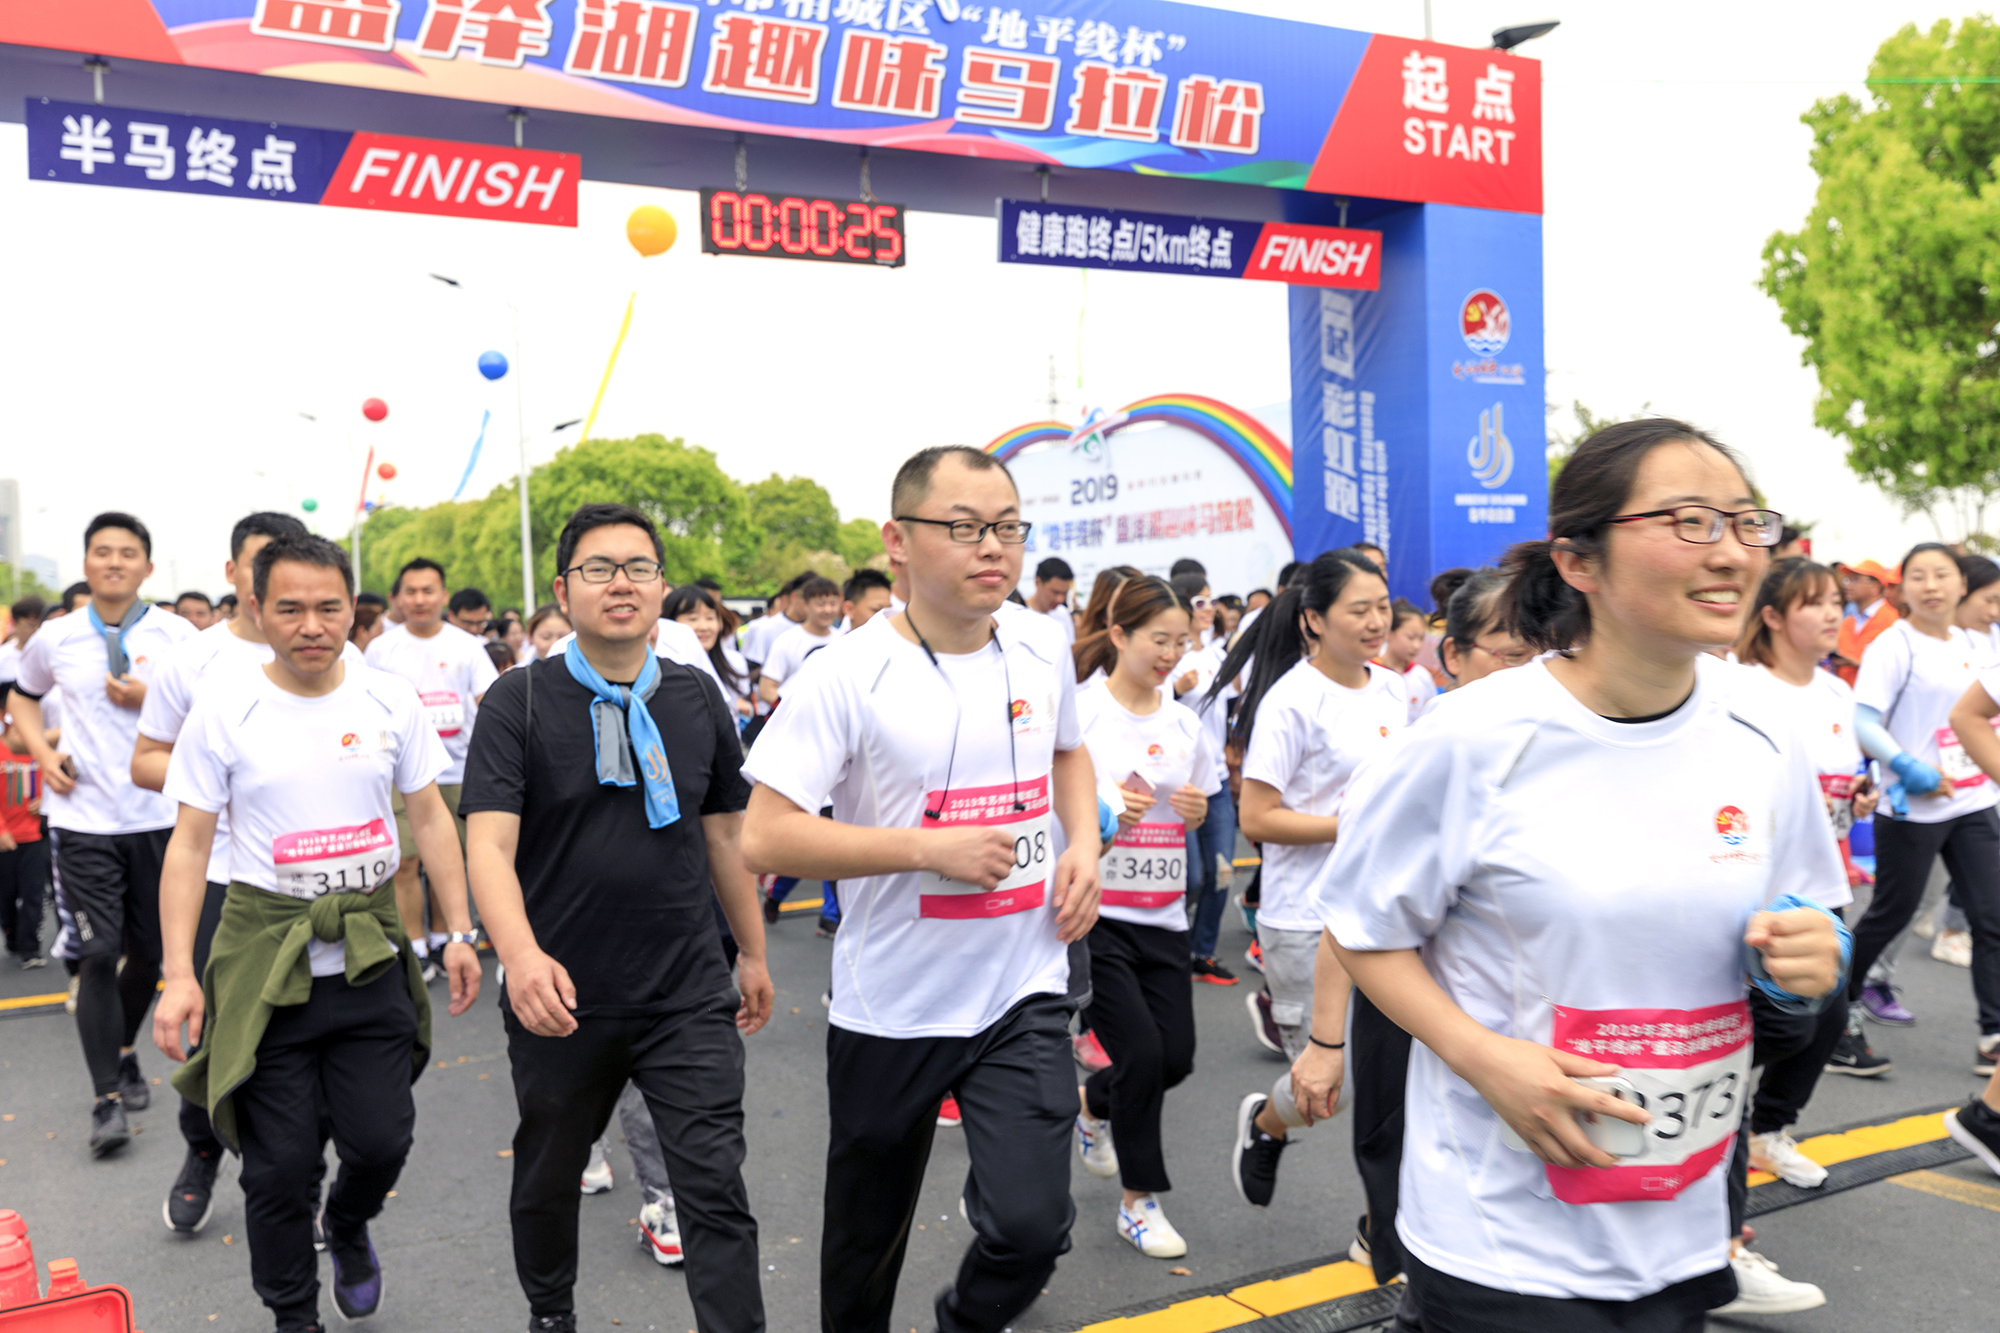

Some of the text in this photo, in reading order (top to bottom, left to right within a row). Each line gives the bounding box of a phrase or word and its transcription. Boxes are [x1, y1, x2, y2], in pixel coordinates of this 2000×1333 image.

[1401, 49, 1516, 124] 起点
[60, 114, 297, 193] 半马终点
[1403, 117, 1516, 166] START
[349, 147, 565, 211] FINISH
[711, 191, 901, 260] 00:00:25
[1016, 209, 1234, 270] 健康跑终点/5km终点
[1258, 233, 1373, 277] FINISH
[1071, 474, 1118, 505] 2019
[1122, 857, 1182, 880] 3430
